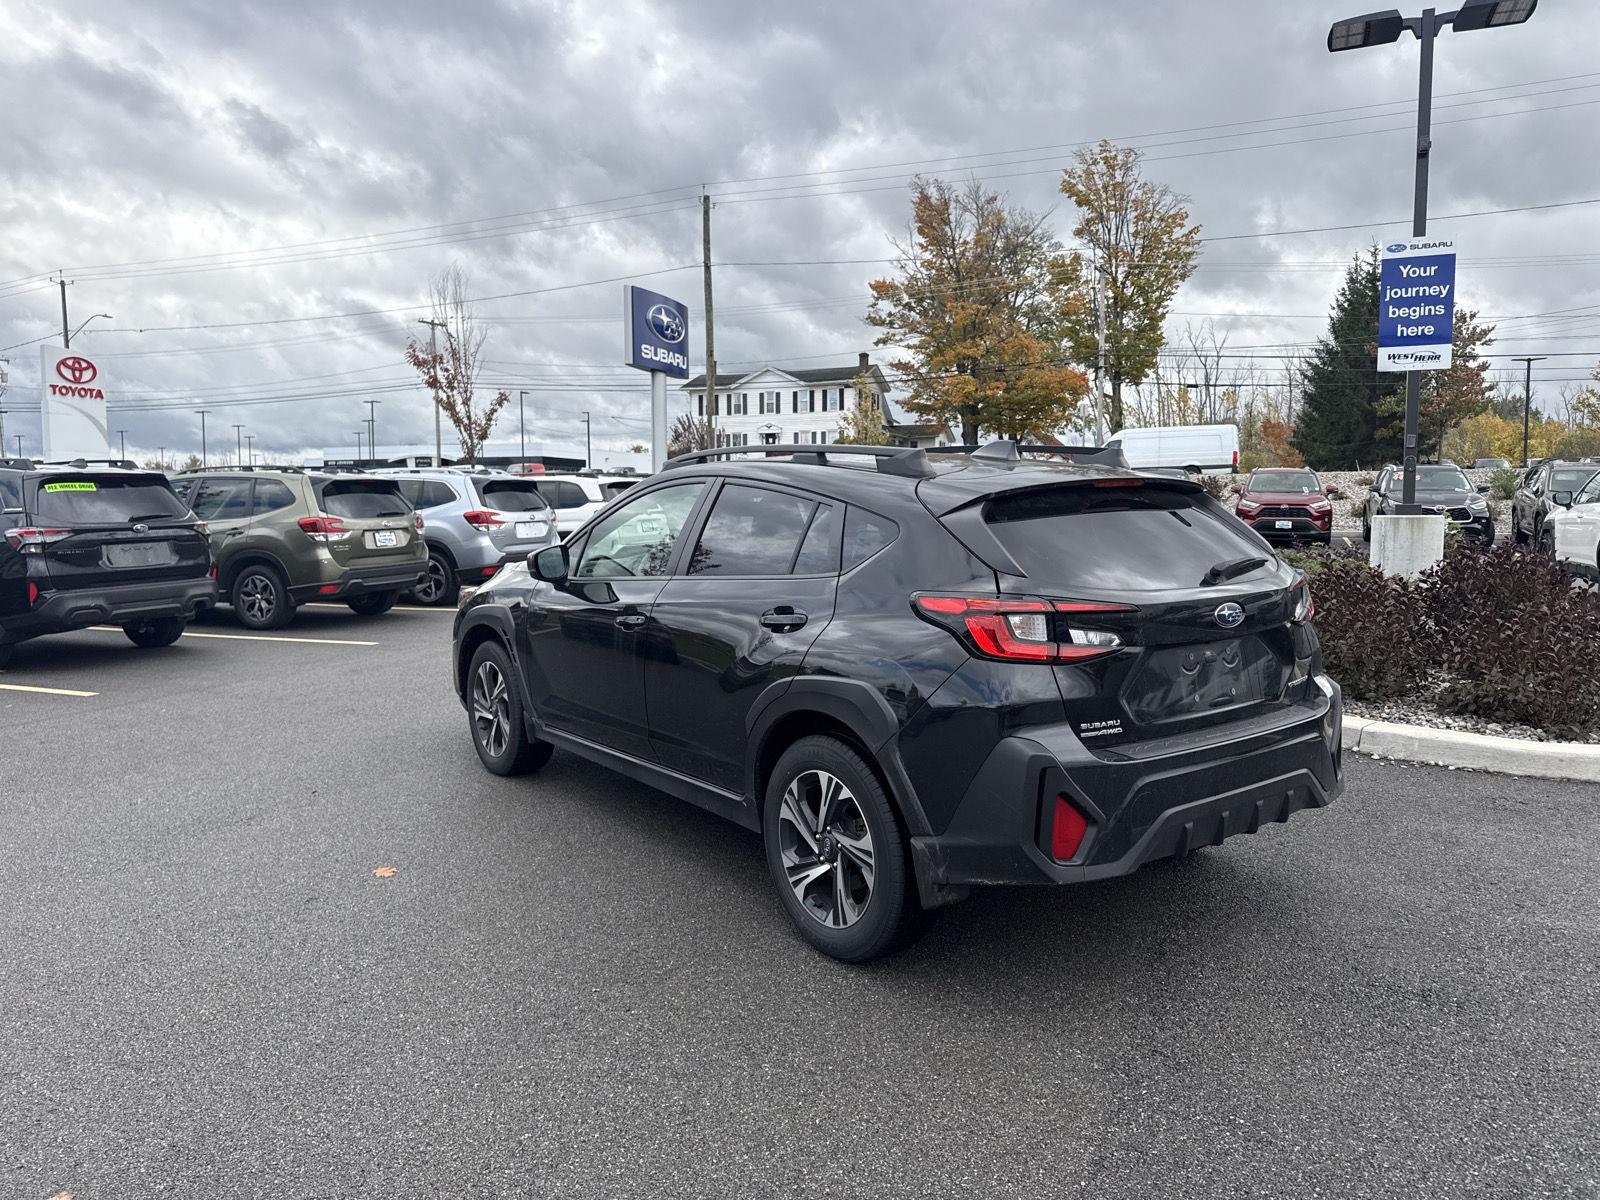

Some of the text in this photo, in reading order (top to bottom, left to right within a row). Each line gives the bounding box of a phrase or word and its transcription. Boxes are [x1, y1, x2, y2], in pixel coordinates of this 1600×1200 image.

[1409, 241, 1453, 250] SUBARU
[1399, 265, 1438, 278] Your
[1384, 284, 1450, 301] journey
[1388, 303, 1445, 319] begins
[1397, 324, 1435, 337] here
[641, 344, 687, 369] SUBARU
[49, 384, 104, 400] TOYOTA
[1080, 720, 1120, 729] SUBARU
